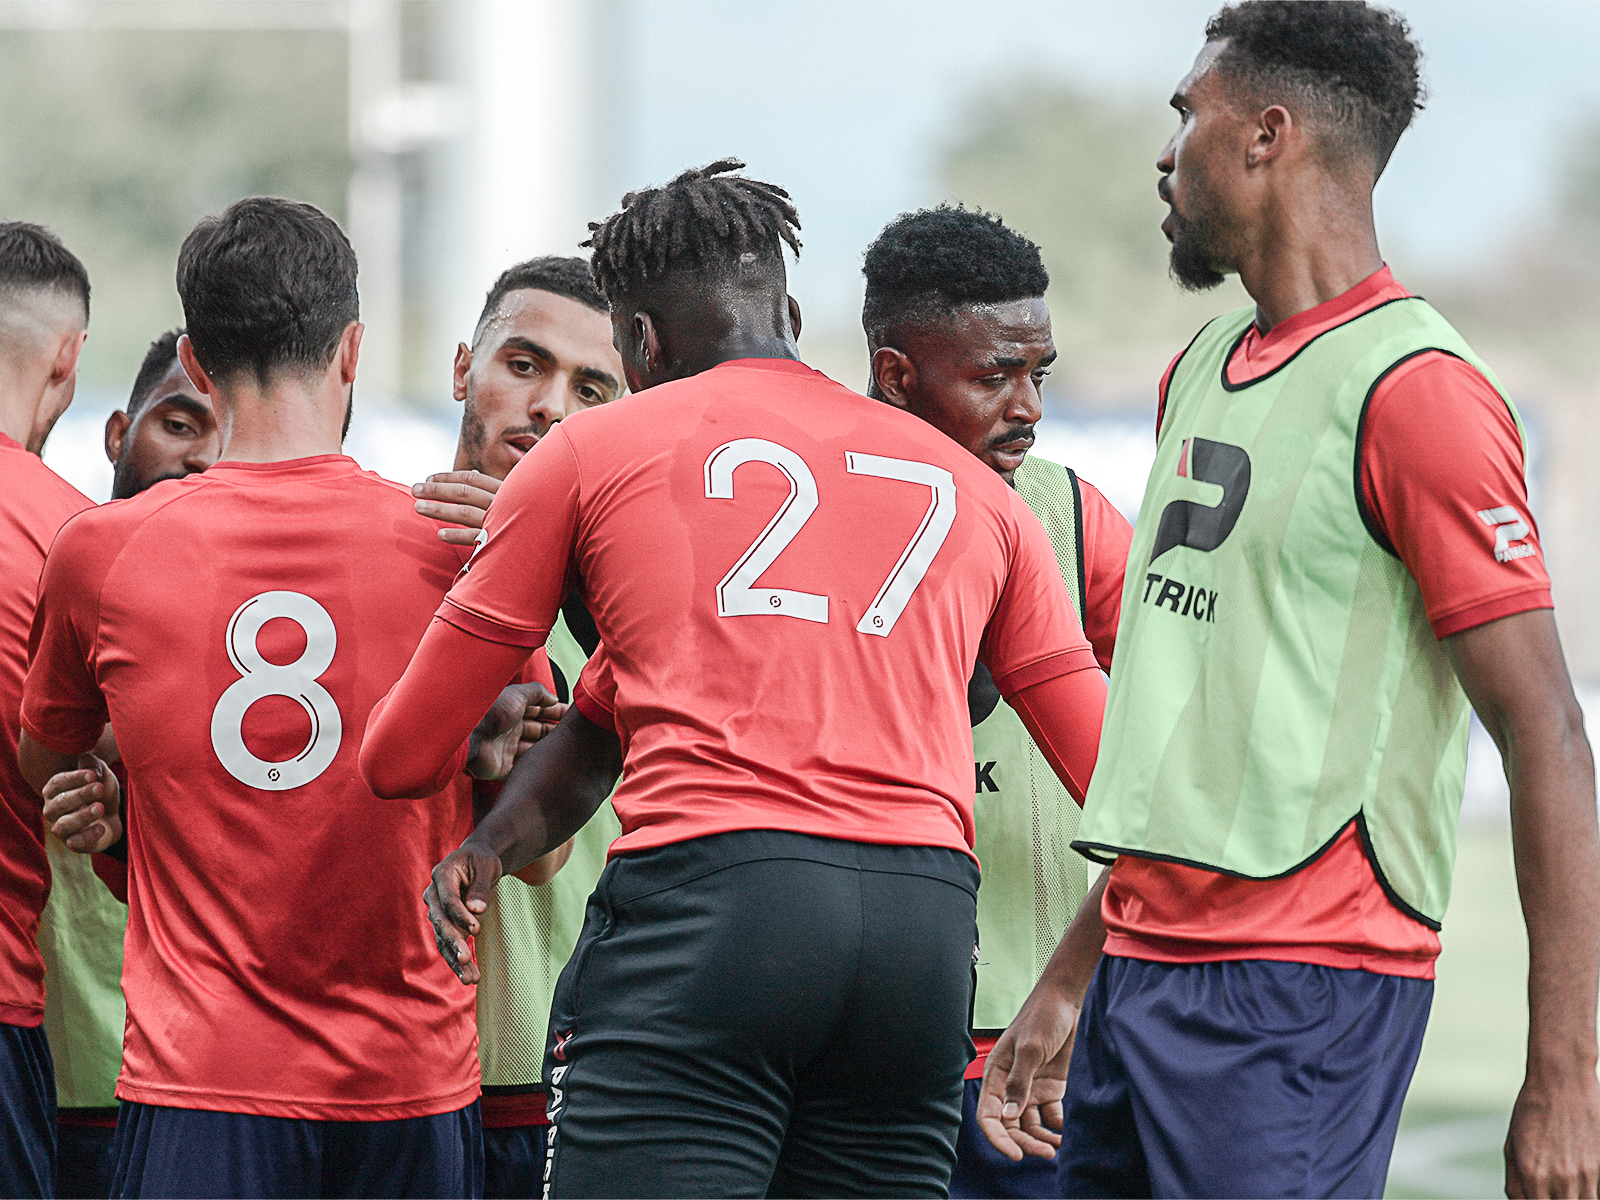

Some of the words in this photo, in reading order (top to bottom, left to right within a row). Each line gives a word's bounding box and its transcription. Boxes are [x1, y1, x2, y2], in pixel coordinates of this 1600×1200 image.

[703, 437, 957, 638] 27
[1143, 573, 1218, 623] TRICK
[210, 590, 342, 791] 8
